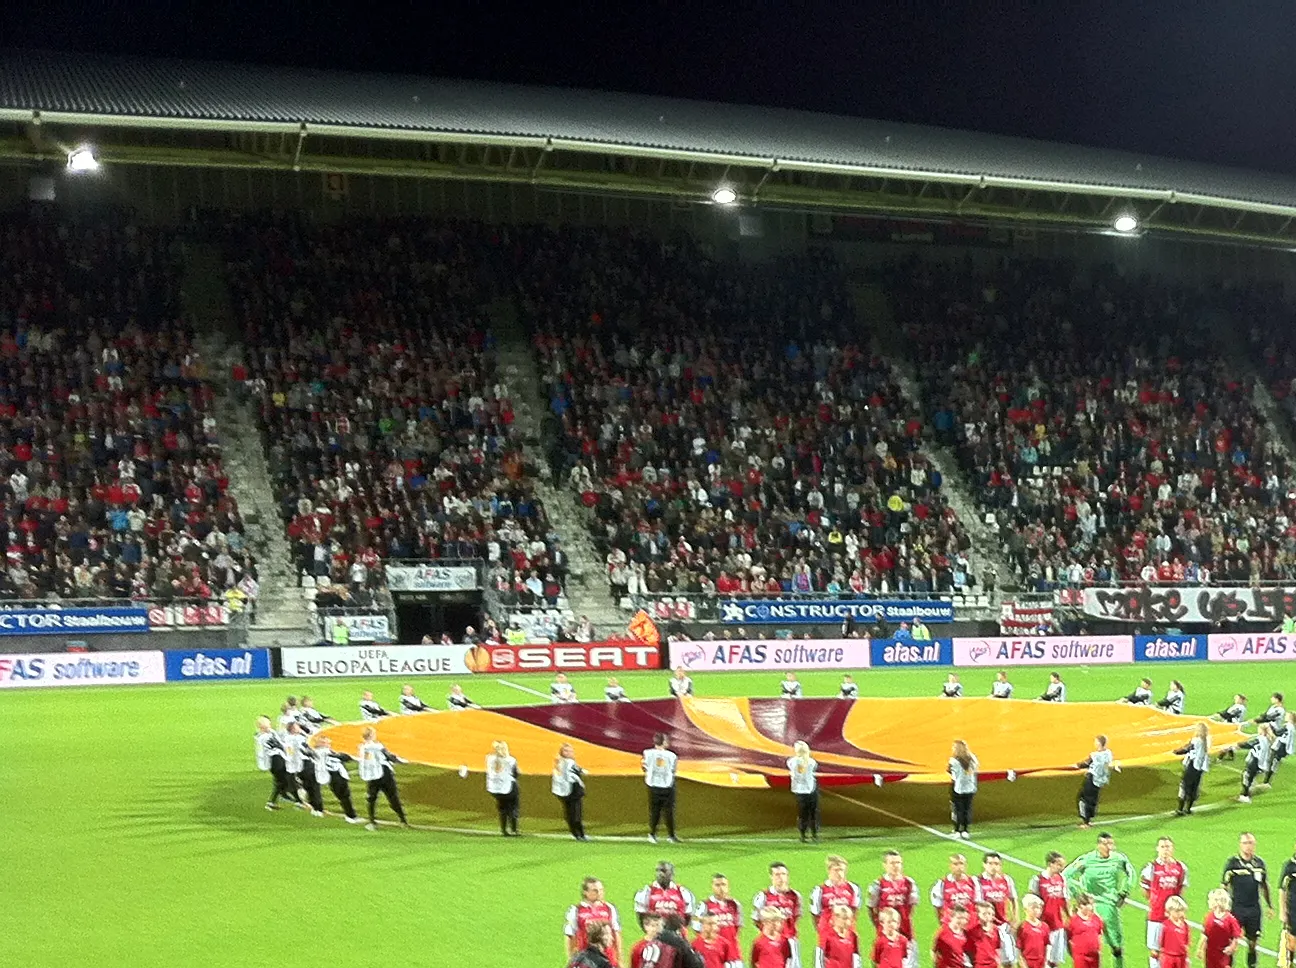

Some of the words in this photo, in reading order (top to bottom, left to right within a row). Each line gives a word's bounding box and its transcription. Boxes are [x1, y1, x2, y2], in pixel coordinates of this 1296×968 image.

[414, 567, 451, 580] AFAS
[359, 650, 390, 660] UEFA
[711, 644, 768, 665] AFAS
[774, 643, 844, 663] software
[884, 641, 941, 662] afas.nl
[996, 641, 1046, 659] AFAS
[1052, 640, 1114, 659] software
[1145, 637, 1198, 657] afas.nl
[1242, 636, 1287, 655] AFAS
[181, 652, 252, 677] afas.nl
[296, 660, 373, 675] EUROPA
[379, 658, 452, 673] LEAGUE
[518, 646, 659, 668] SEAT
[53, 658, 140, 681] software
